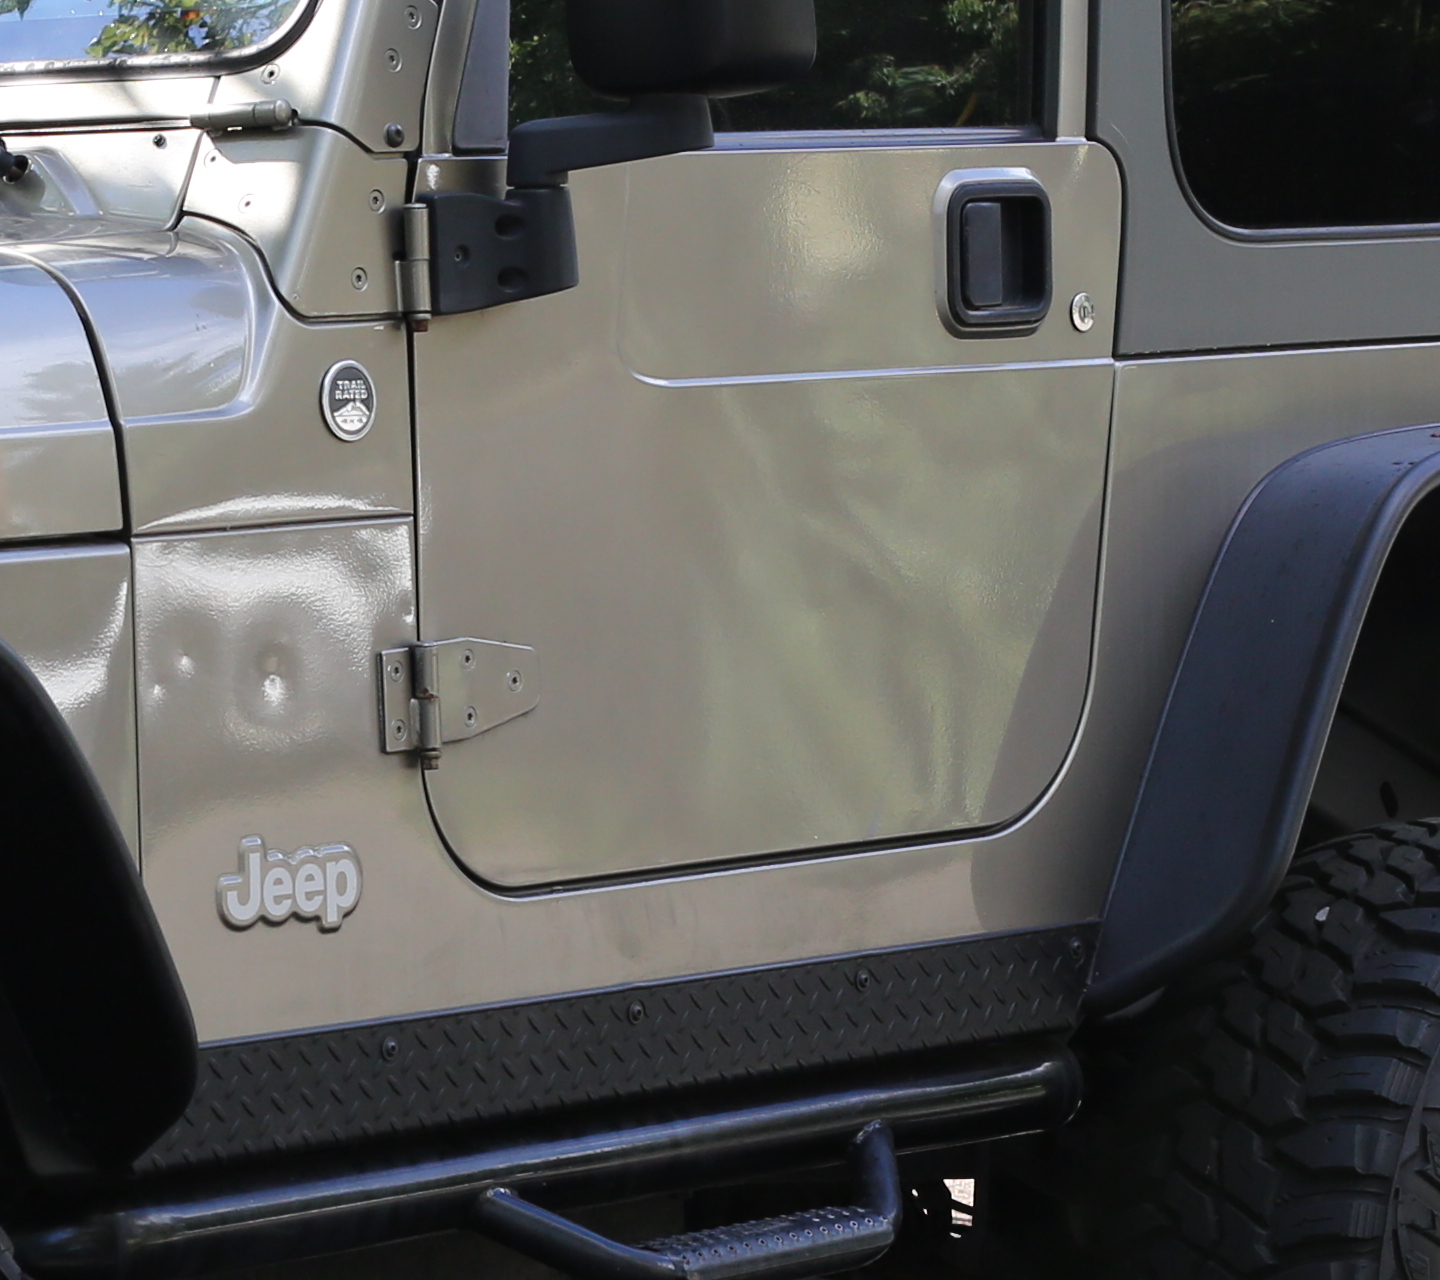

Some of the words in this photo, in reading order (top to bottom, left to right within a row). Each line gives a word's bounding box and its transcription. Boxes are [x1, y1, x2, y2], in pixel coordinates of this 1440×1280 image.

[336, 380, 366, 390] TRAIL
[335, 389, 368, 400] RATED
[221, 842, 360, 927] Jeep
